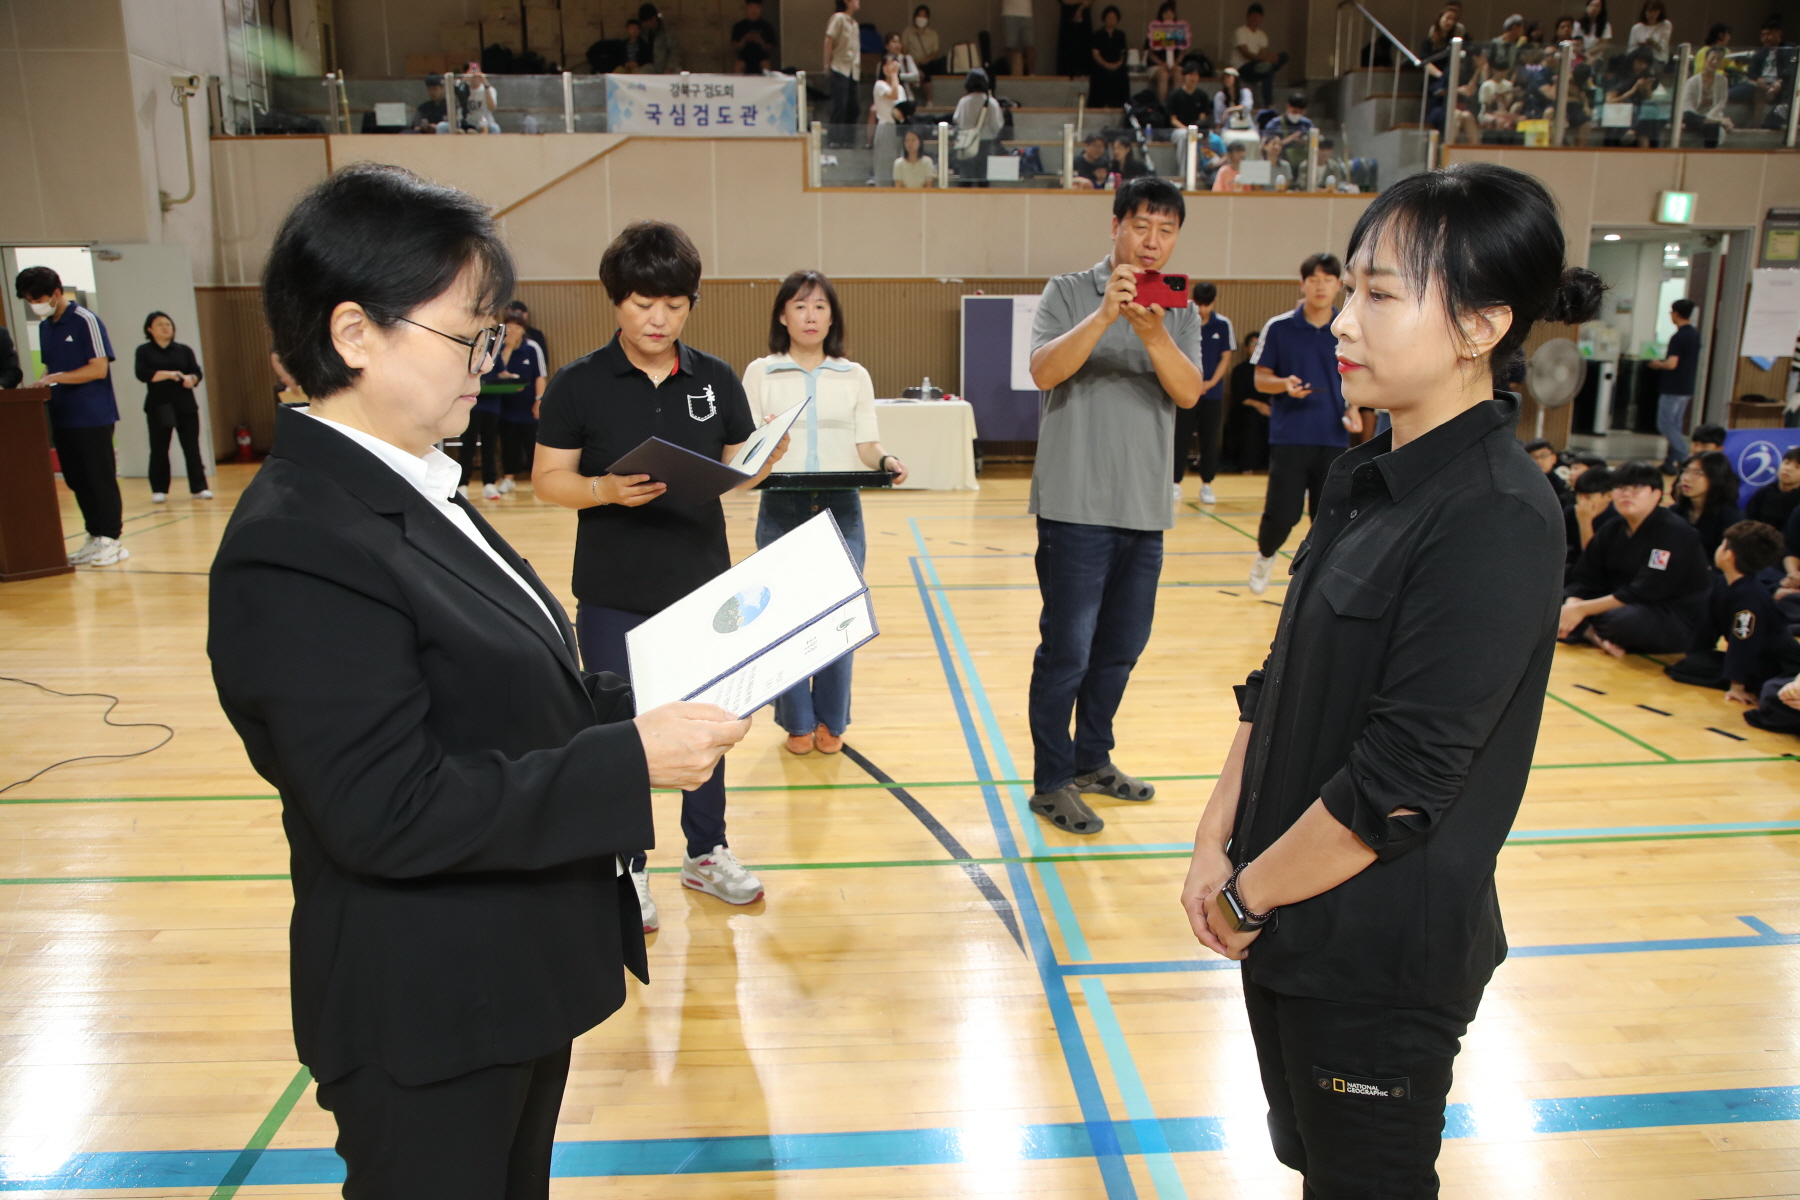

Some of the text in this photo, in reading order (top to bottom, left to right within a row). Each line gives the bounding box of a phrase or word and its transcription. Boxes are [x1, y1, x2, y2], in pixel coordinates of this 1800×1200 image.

[669, 83, 735, 98] 강북구 검도회
[1346, 1081, 1379, 1091] NATIONAL
[1346, 1087, 1389, 1097] GEOGRAPHIC
